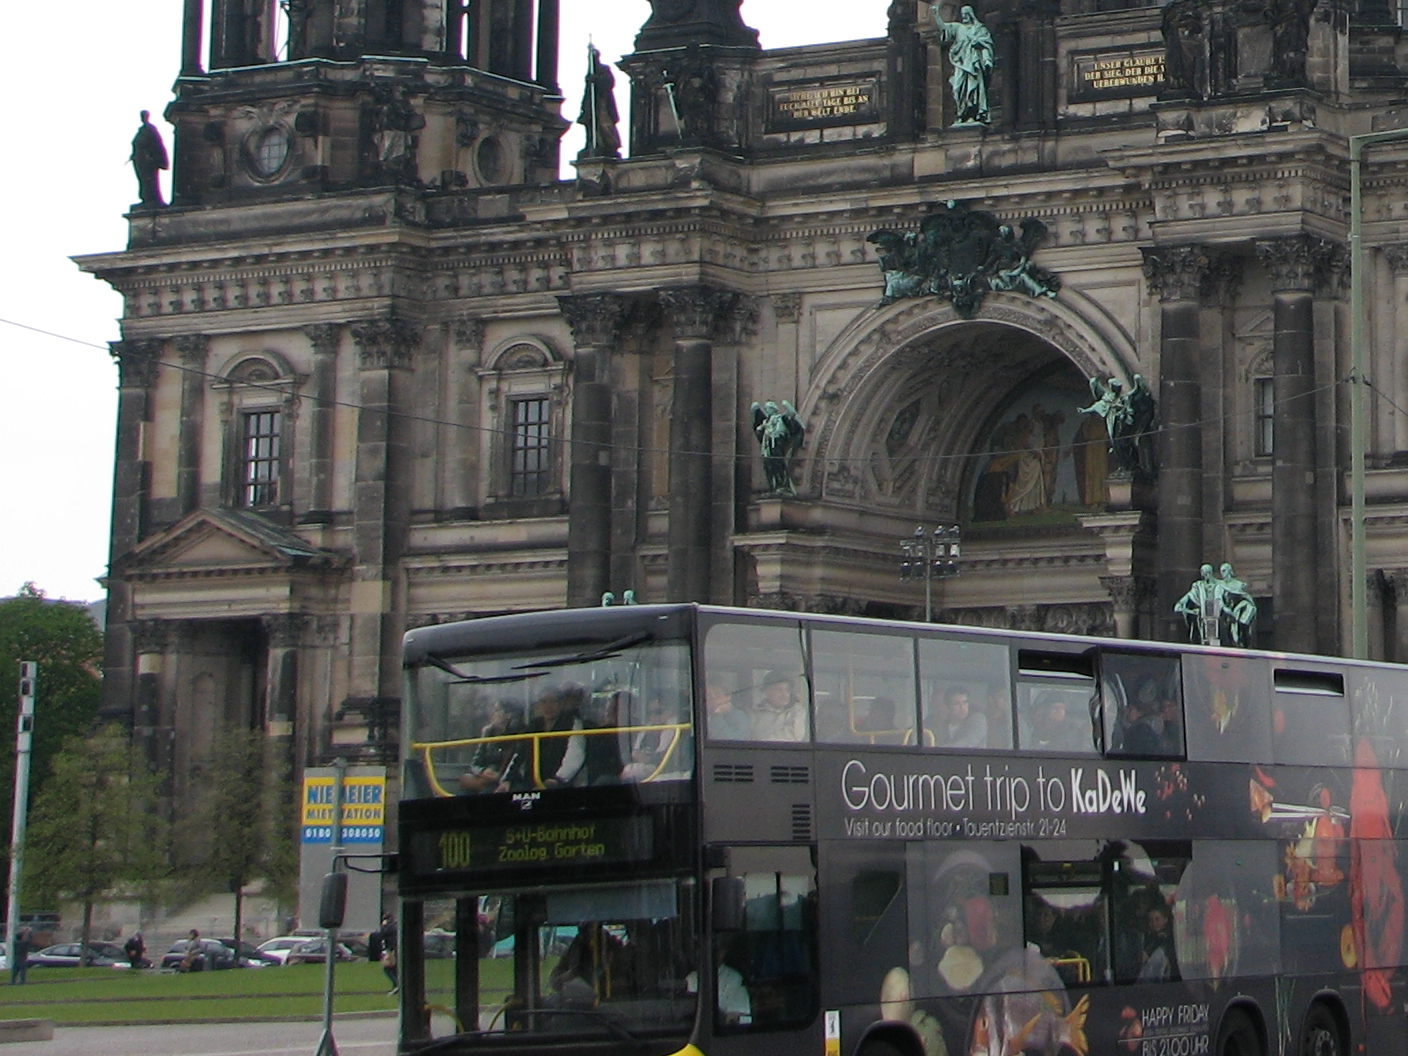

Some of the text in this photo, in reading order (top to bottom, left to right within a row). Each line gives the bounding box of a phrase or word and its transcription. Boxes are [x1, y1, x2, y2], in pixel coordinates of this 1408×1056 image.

[512, 792, 541, 801] MAN
[841, 759, 1147, 820] Gourmet trip to KaDeWe
[844, 817, 869, 836] Visit
[872, 821, 892, 836] our
[895, 817, 924, 836] food
[927, 817, 953, 837] floor
[1039, 818, 1067, 836] 21-24
[438, 831, 471, 868] 100
[1142, 1004, 1210, 1027] HAPPY FRIDAY
